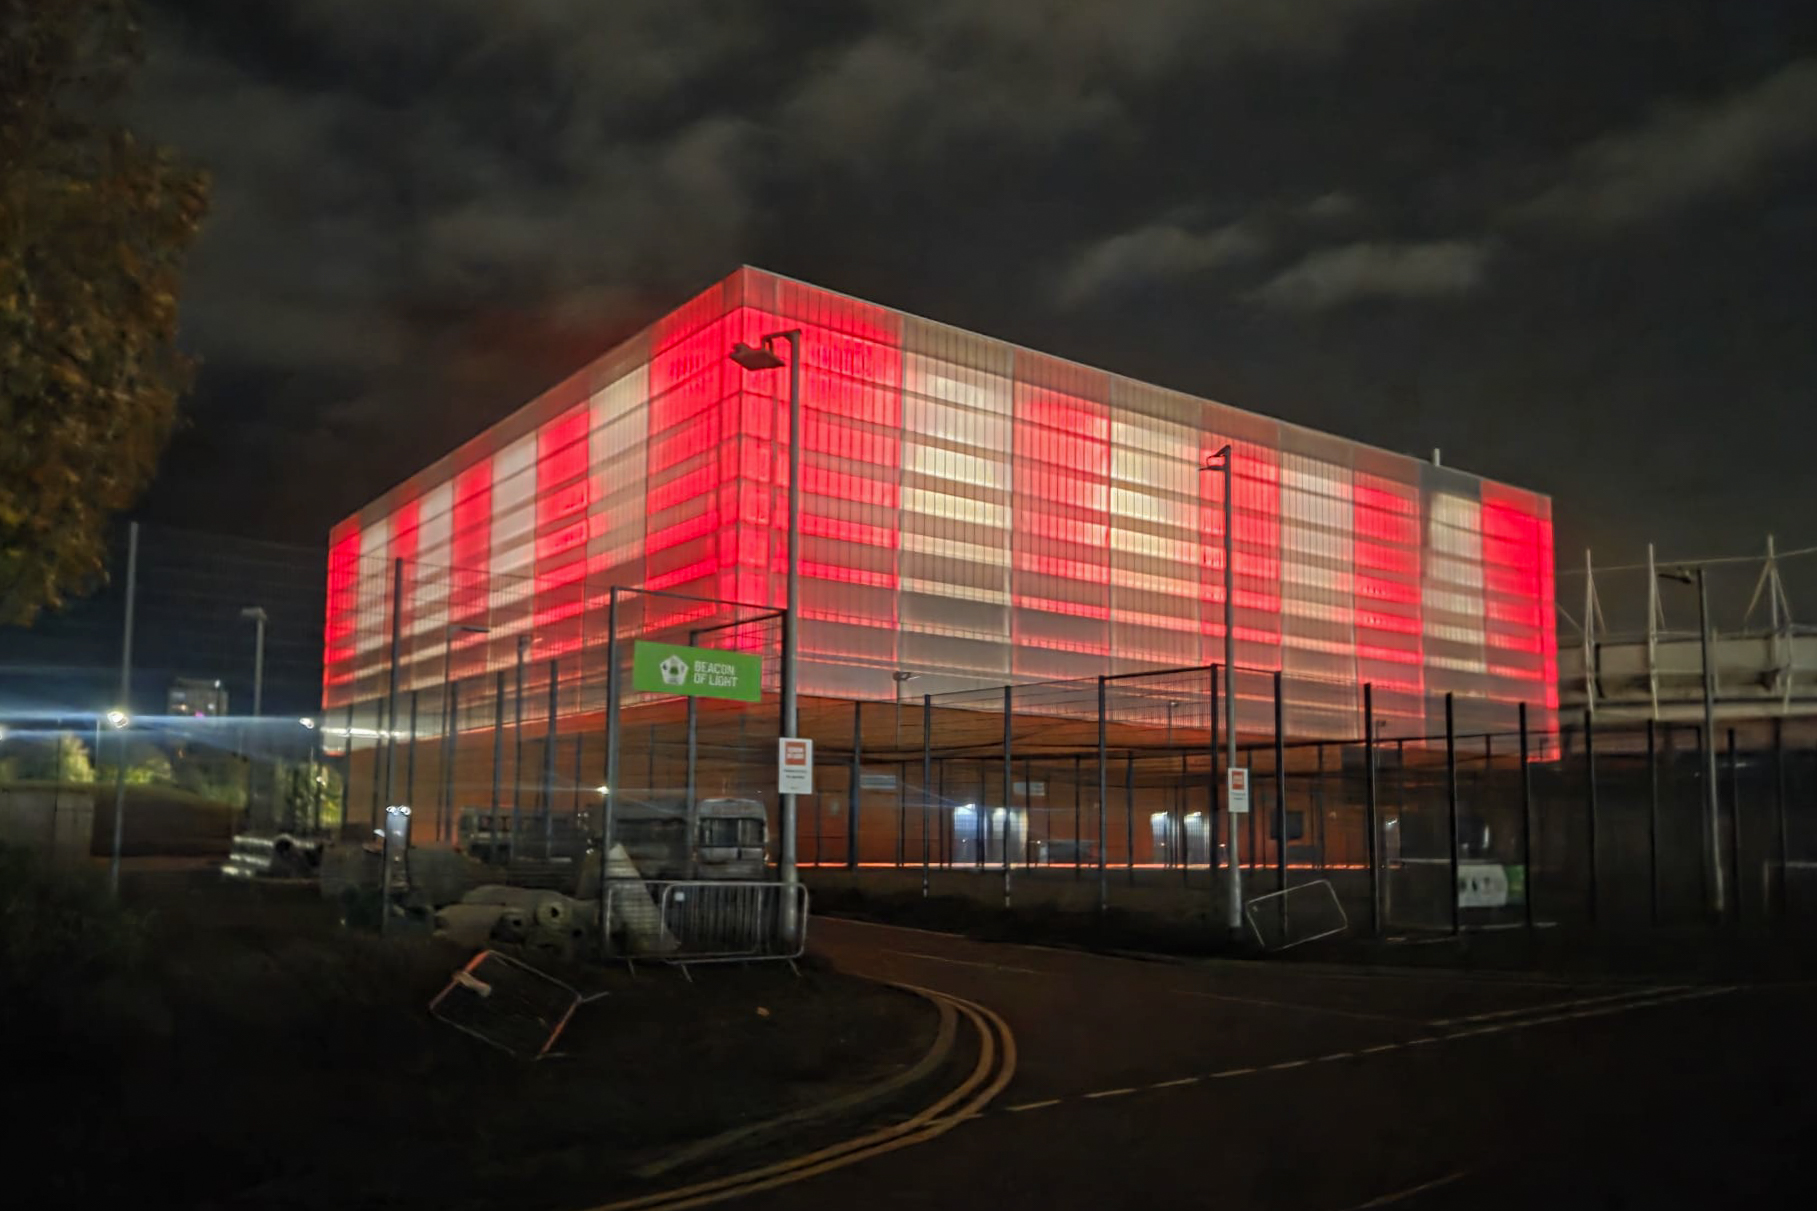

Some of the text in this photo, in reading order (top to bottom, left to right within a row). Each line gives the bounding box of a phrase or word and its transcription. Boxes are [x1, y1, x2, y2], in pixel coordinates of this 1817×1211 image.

[694, 660, 735, 675] BEACON
[694, 672, 738, 687] OF LIGHT
